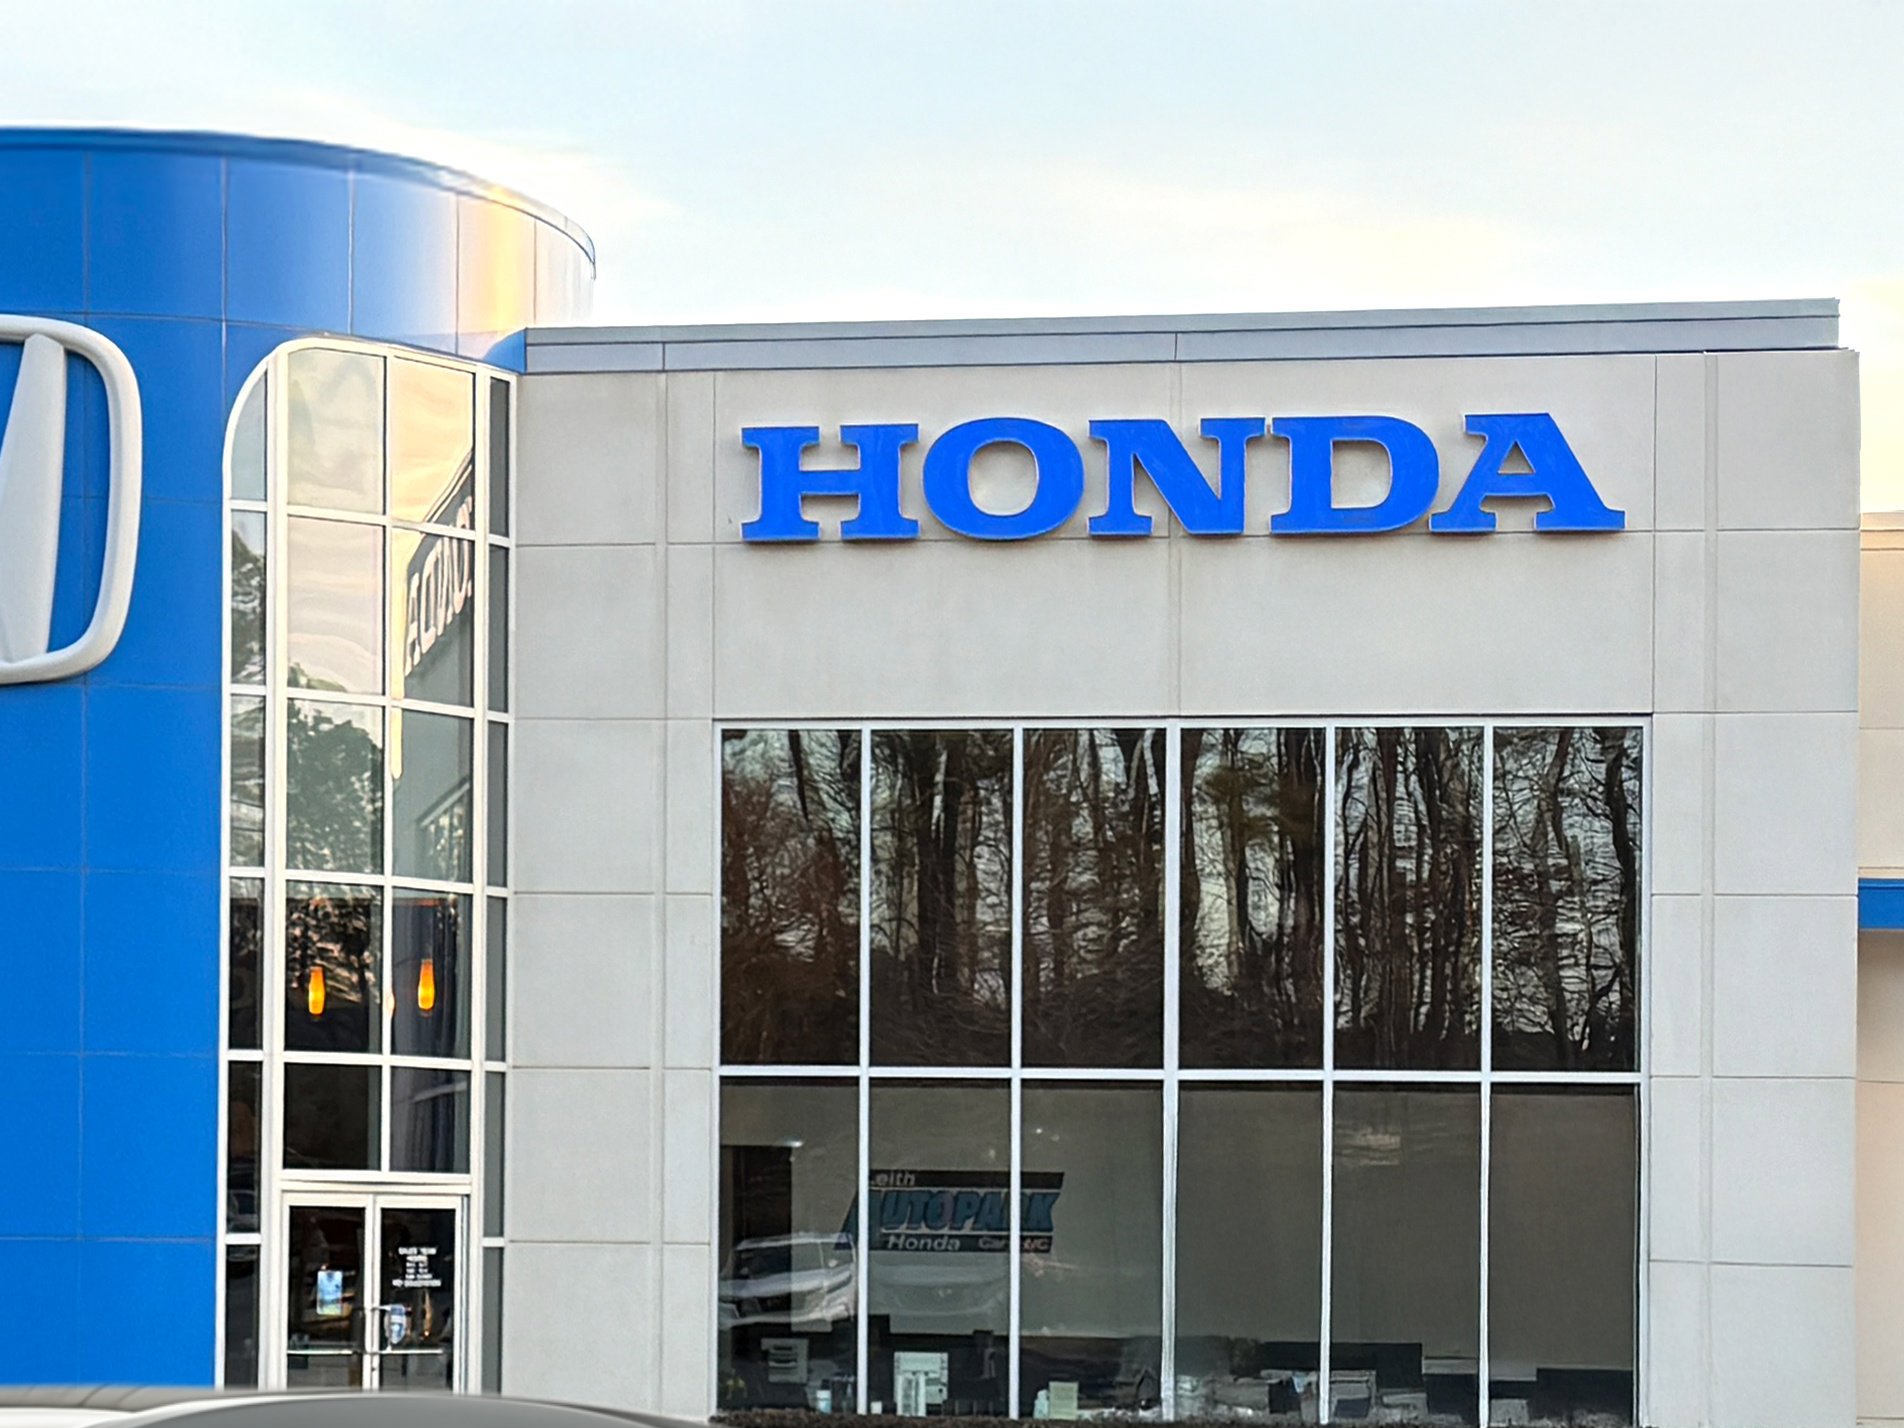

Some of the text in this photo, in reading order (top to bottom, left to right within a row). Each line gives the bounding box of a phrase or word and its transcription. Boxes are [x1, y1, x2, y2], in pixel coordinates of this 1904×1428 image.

[740, 411, 1626, 541] HONDA
[869, 1170, 916, 1187] eith
[887, 1235, 961, 1250] Honda
